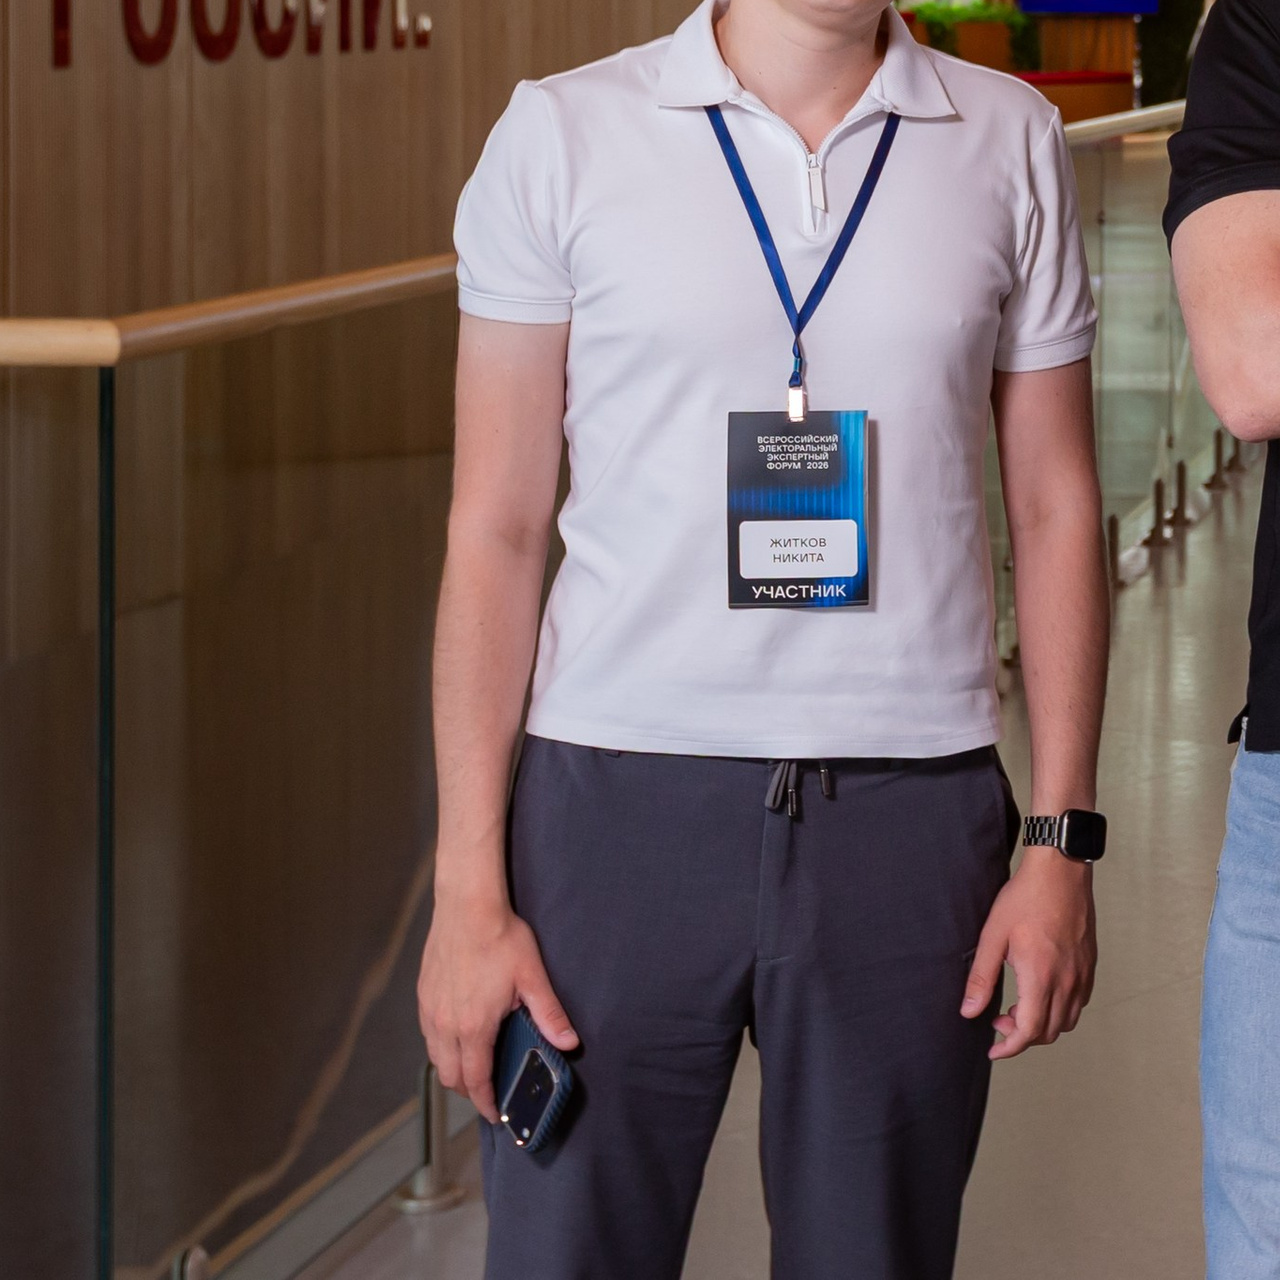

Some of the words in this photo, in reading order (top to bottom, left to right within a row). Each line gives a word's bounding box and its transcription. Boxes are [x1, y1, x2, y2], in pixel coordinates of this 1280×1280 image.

[757, 434, 839, 444] ВСЕРОССИЙСКИЙ
[758, 443, 838, 453] ЭЛЕКТОРАЛЬНЫЙ
[766, 452, 829, 461] ЭКСПЕРТНЫЙ
[766, 461, 801, 470] ФОРУМ
[806, 461, 829, 470] 2026
[769, 537, 827, 548] ЖИТКОВ
[772, 553, 825, 563] НИКИТА
[752, 584, 847, 599] УЧАСТНИК
